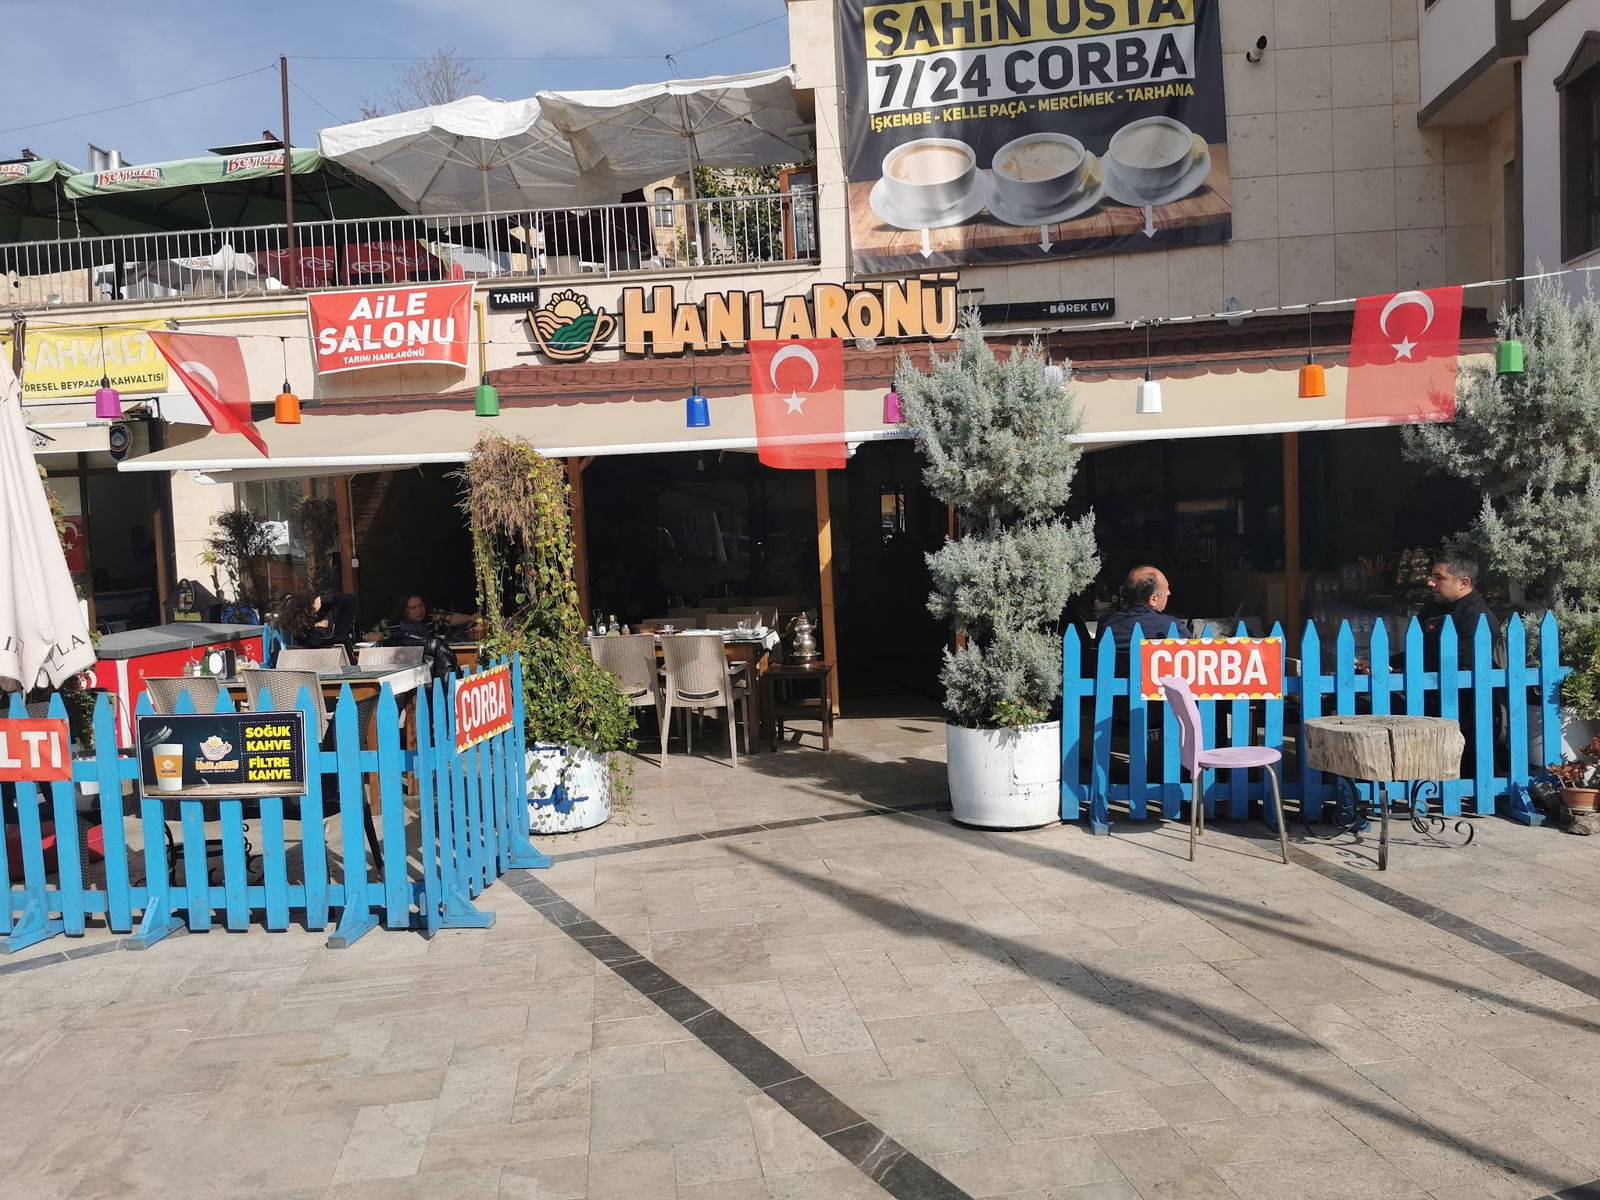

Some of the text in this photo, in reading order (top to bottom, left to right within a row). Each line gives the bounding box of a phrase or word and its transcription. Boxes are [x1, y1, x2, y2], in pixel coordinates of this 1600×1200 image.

[875, 33, 1188, 109] 7/24 ÇORBA
[870, 83, 1194, 133] İŞKEMBE KELLE PAÇA MERCİMEK TARHANA
[1050, 303, 1088, 314] BÖREK
[319, 316, 455, 356] SALONU
[372, 347, 425, 362] HANLARÖNÜ
[21, 381, 58, 392] ÖRESEL
[111, 373, 164, 386] KAHVALTISI
[1151, 649, 1268, 695] ÇORBA
[461, 678, 507, 742] ÇORBA
[245, 724, 291, 738] SOĞUK
[246, 740, 292, 752] KAHVE
[249, 755, 290, 769] FİLTRE
[248, 769, 292, 781] KAHVE
